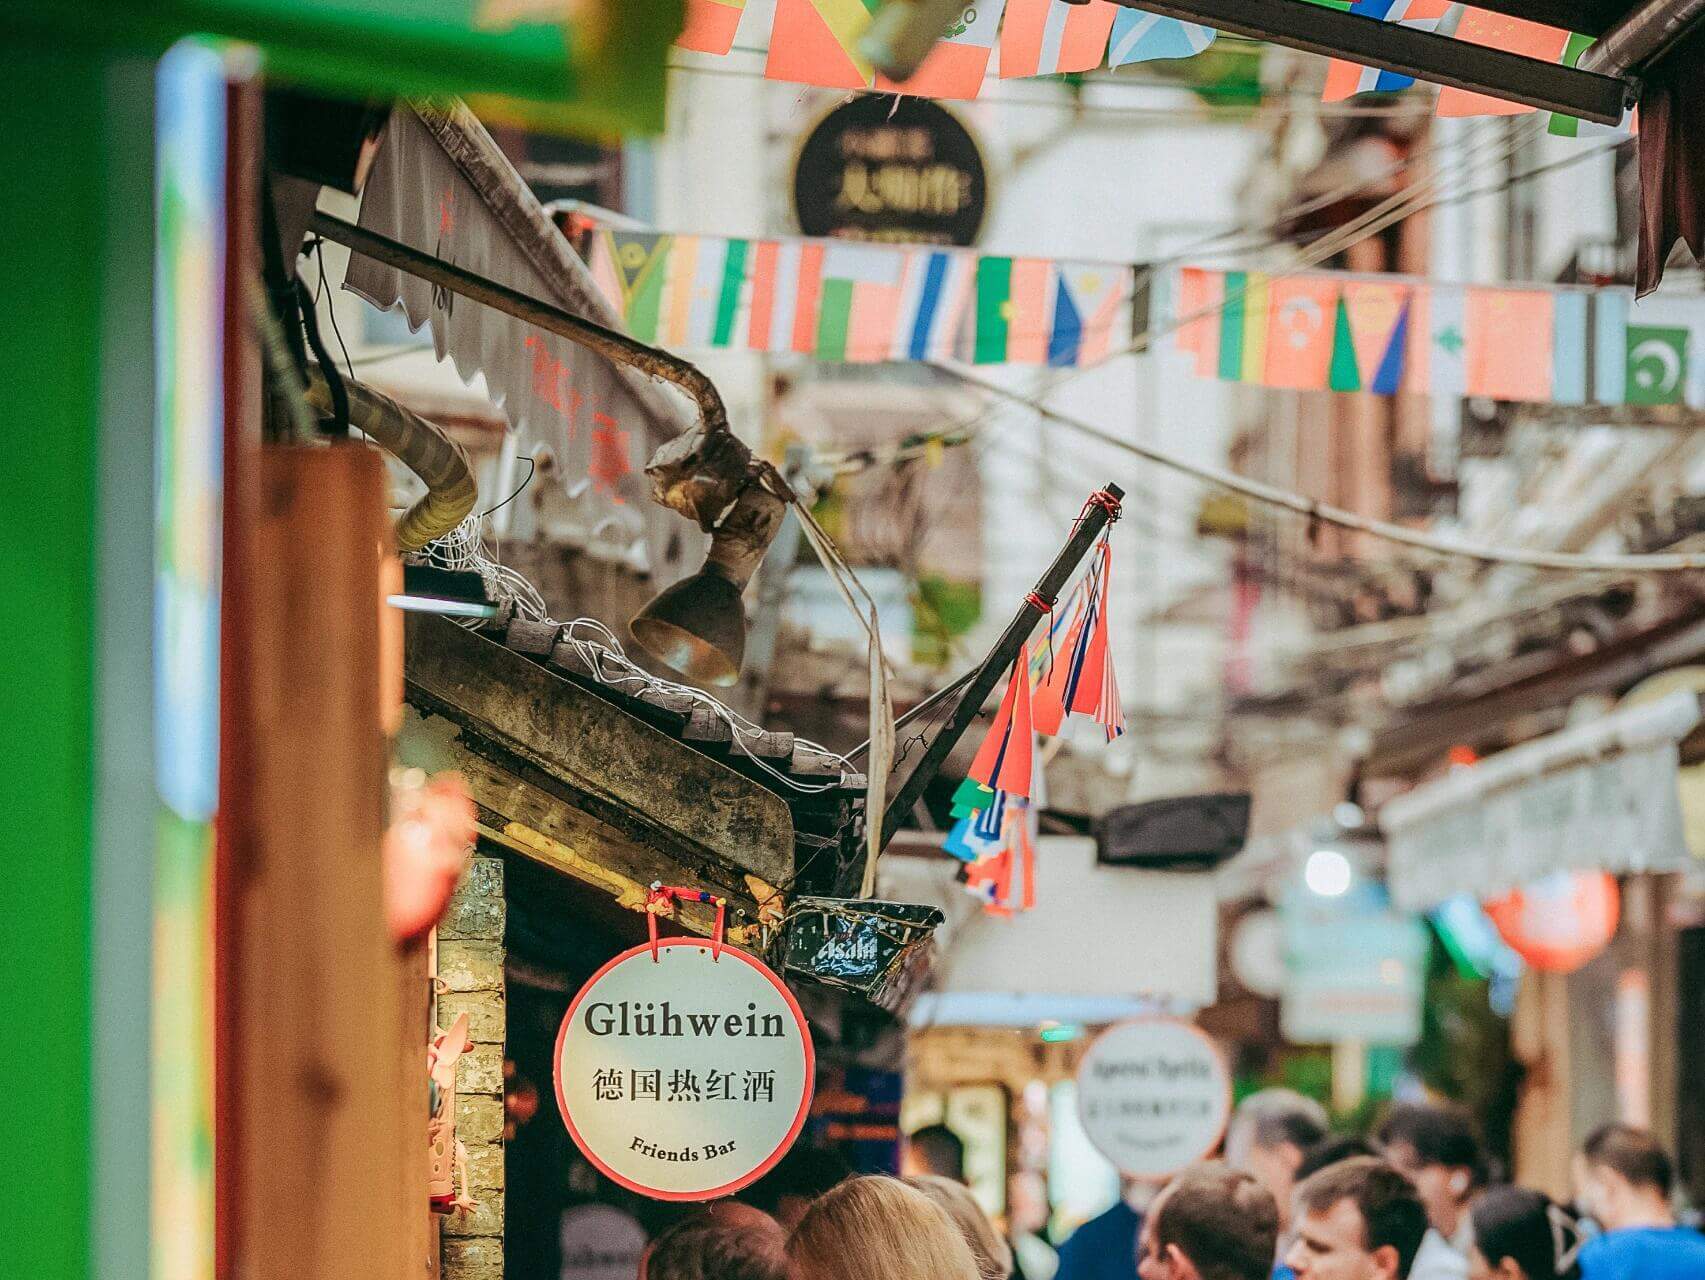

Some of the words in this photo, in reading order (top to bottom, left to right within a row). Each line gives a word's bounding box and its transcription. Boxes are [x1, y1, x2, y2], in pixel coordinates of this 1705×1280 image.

[584, 1001, 786, 1038] Glühwein
[590, 1068, 777, 1103] 德国热红酒
[629, 1136, 700, 1163] Friends
[702, 1138, 737, 1161] Bar
